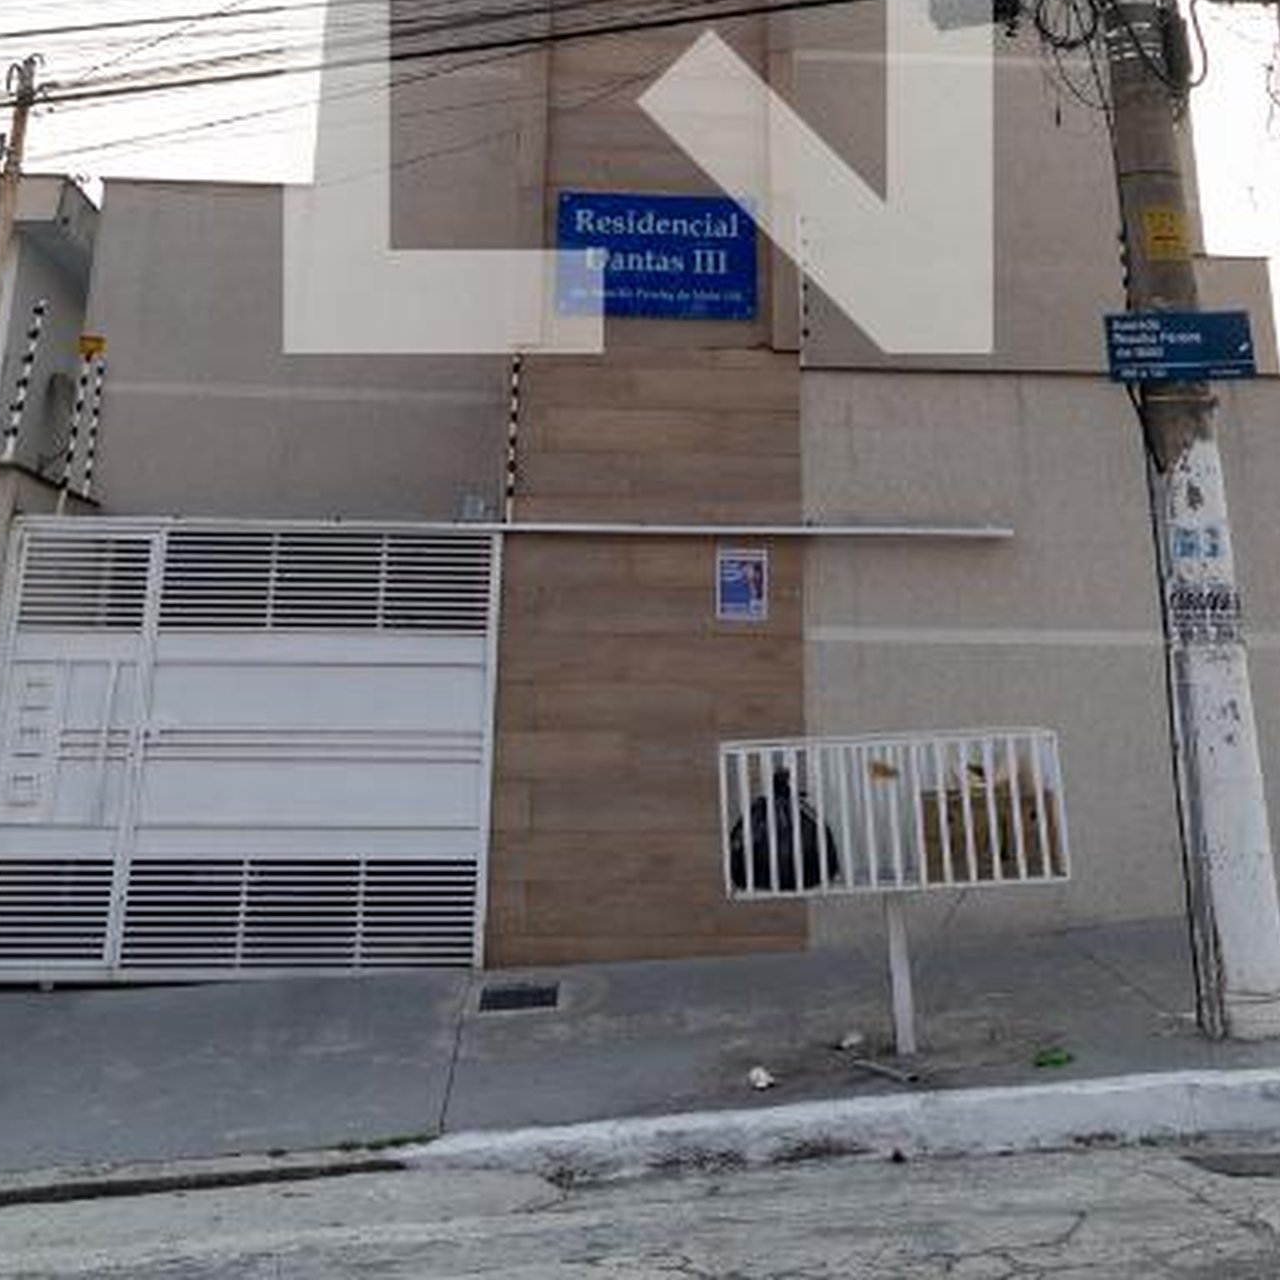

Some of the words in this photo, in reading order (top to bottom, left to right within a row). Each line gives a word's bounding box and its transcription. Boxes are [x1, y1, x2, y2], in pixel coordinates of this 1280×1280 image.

[575, 209, 739, 238] Residencial
[586, 247, 685, 272] Dantas
[693, 249, 727, 274] III
